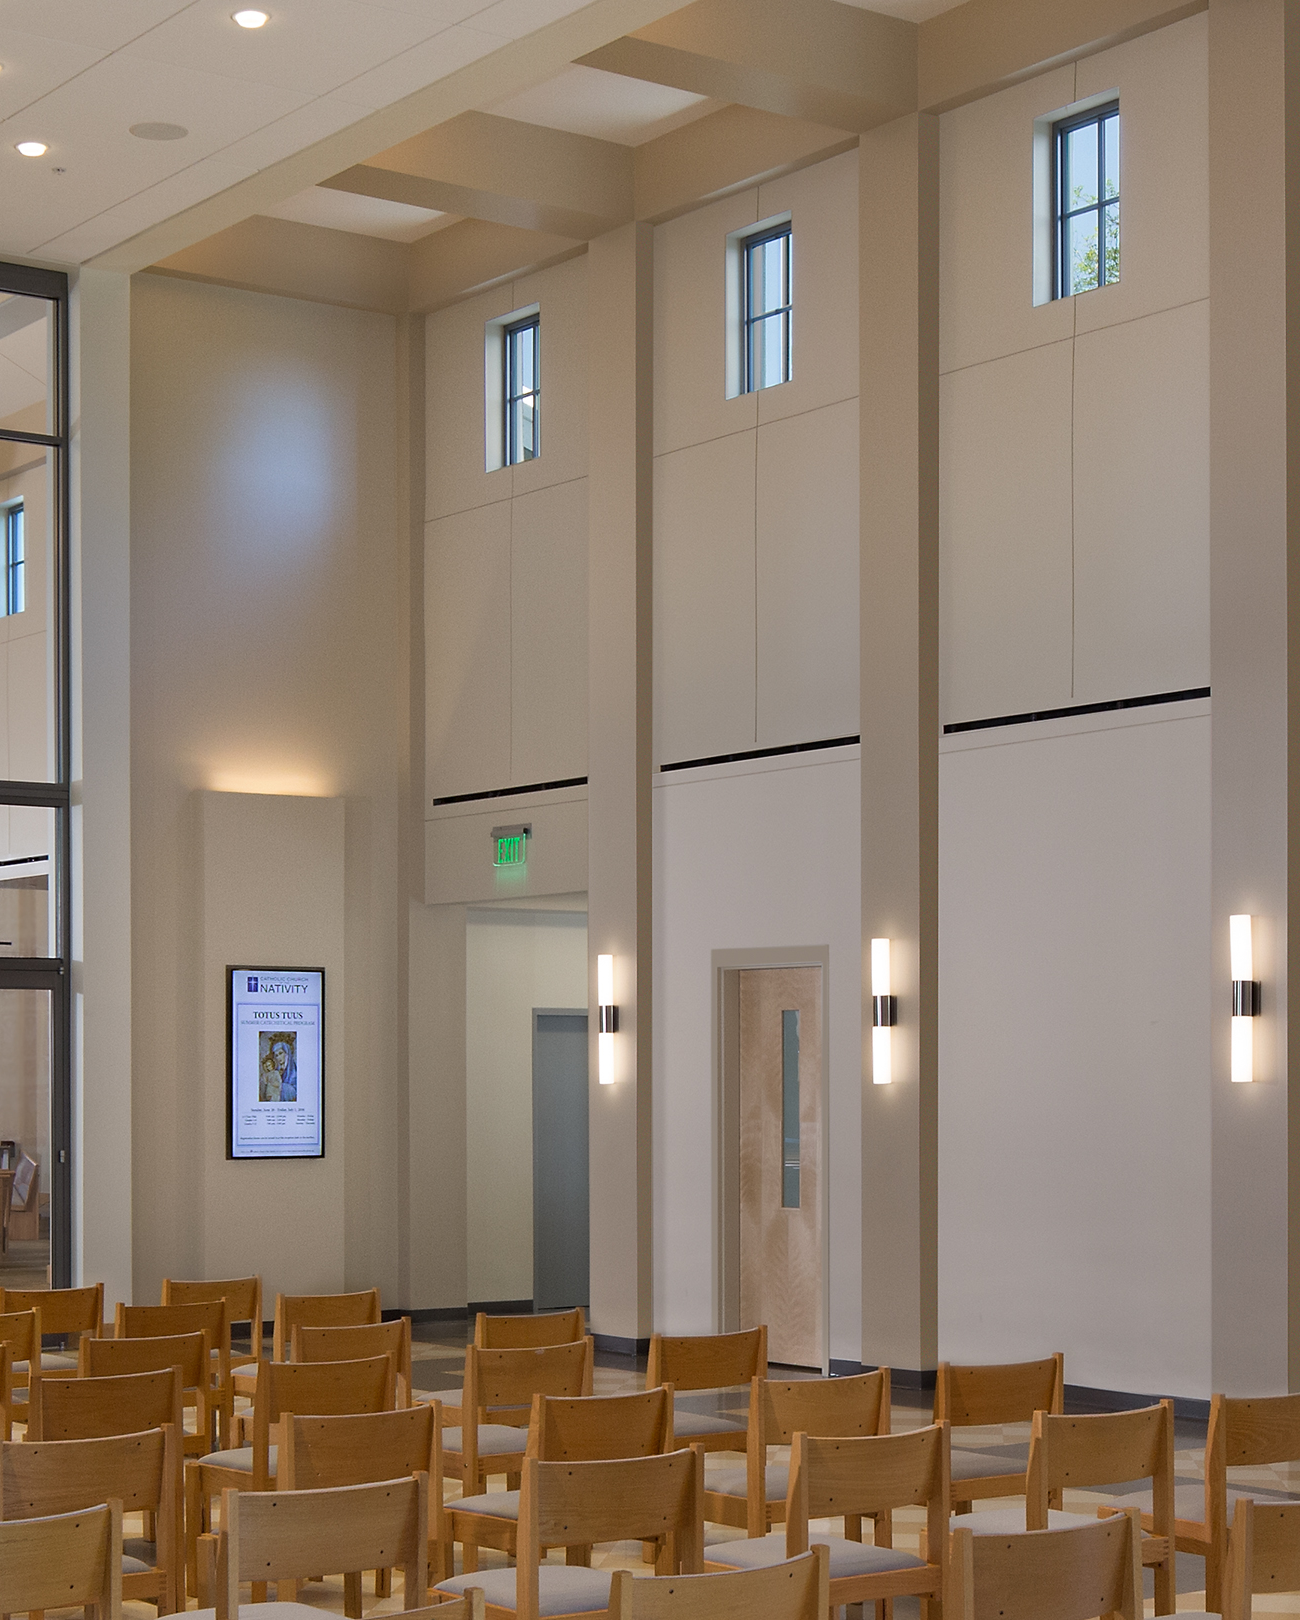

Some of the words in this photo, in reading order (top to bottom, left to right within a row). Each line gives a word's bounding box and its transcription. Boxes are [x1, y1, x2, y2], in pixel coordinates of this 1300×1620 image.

[497, 837, 520, 863] EXIT
[260, 984, 308, 993] NATIVITY
[253, 1011, 280, 1019] TOTUS
[281, 1011, 303, 1020] TUUS
